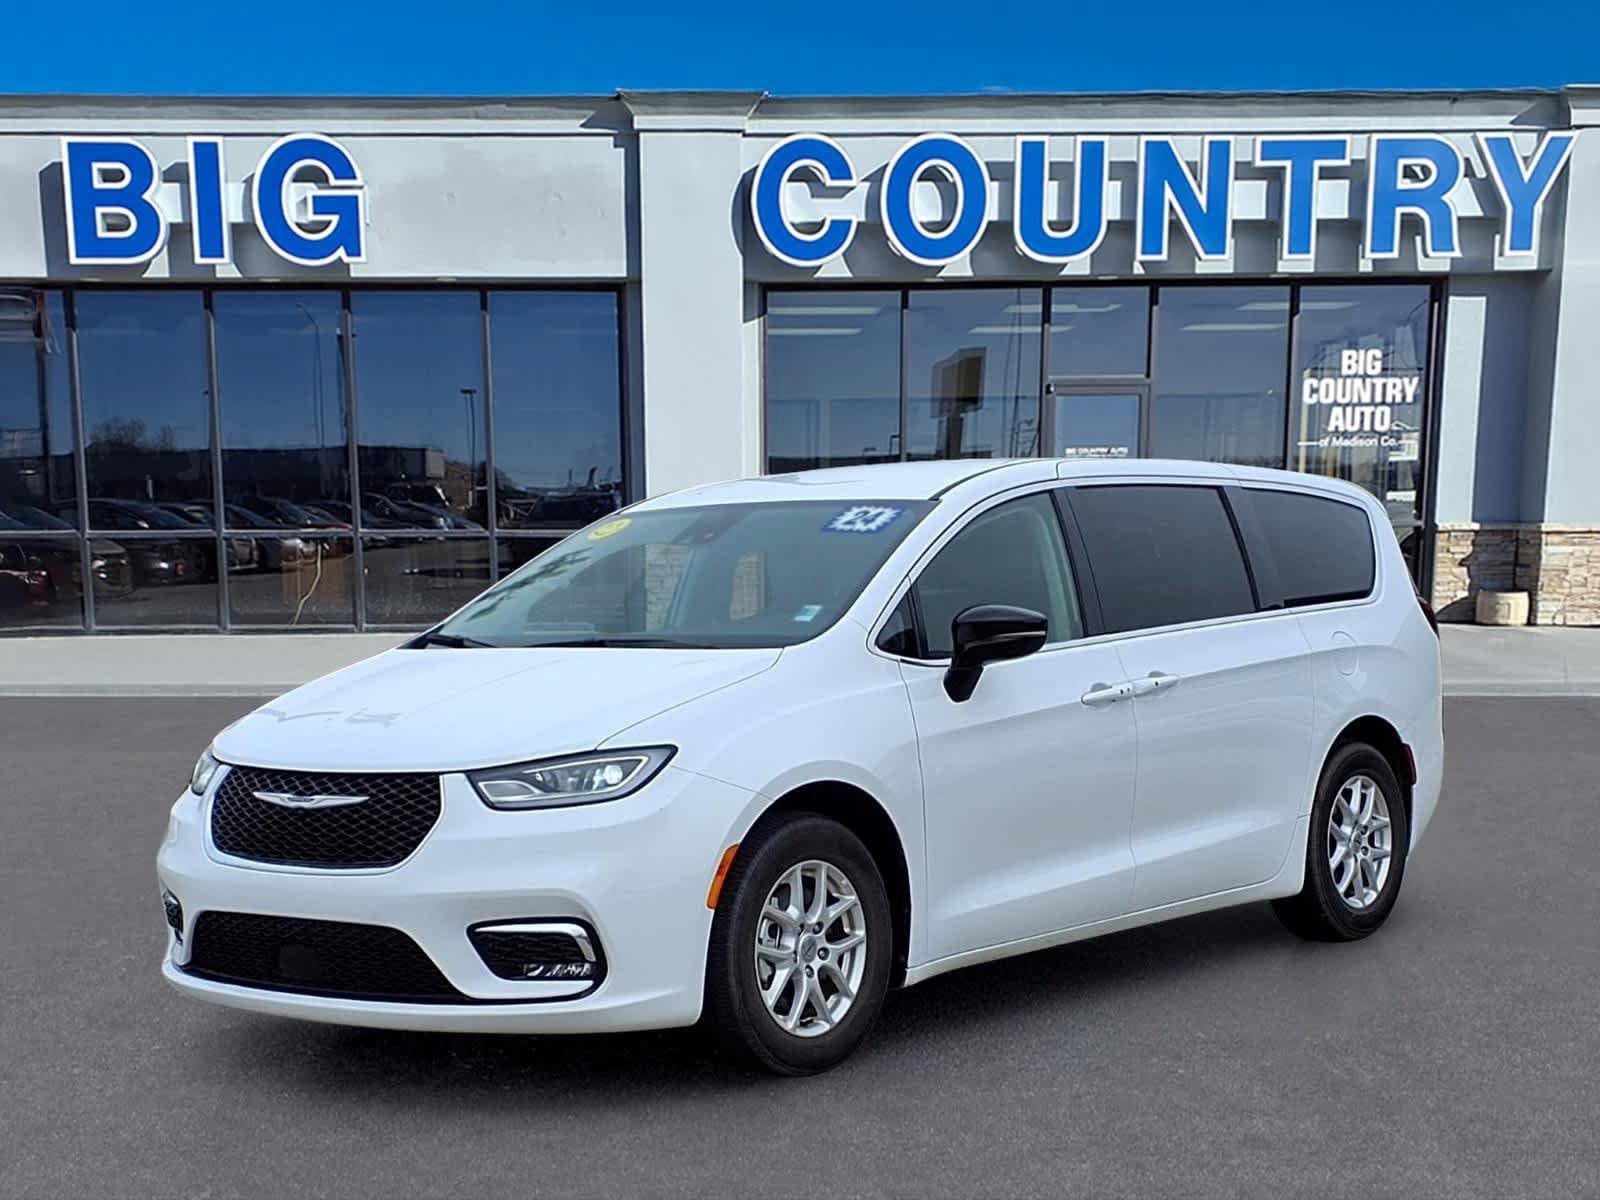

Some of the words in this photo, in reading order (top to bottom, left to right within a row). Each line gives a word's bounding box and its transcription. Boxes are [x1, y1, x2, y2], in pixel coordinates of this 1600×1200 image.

[61, 133, 367, 265] BIG
[750, 131, 1574, 268] COUNTRY
[1341, 349, 1382, 375] BIG
[1302, 377, 1419, 404] COUNTRY
[1327, 405, 1391, 432] AUTO
[1319, 436, 1331, 447] of
[1331, 435, 1379, 447] Madison
